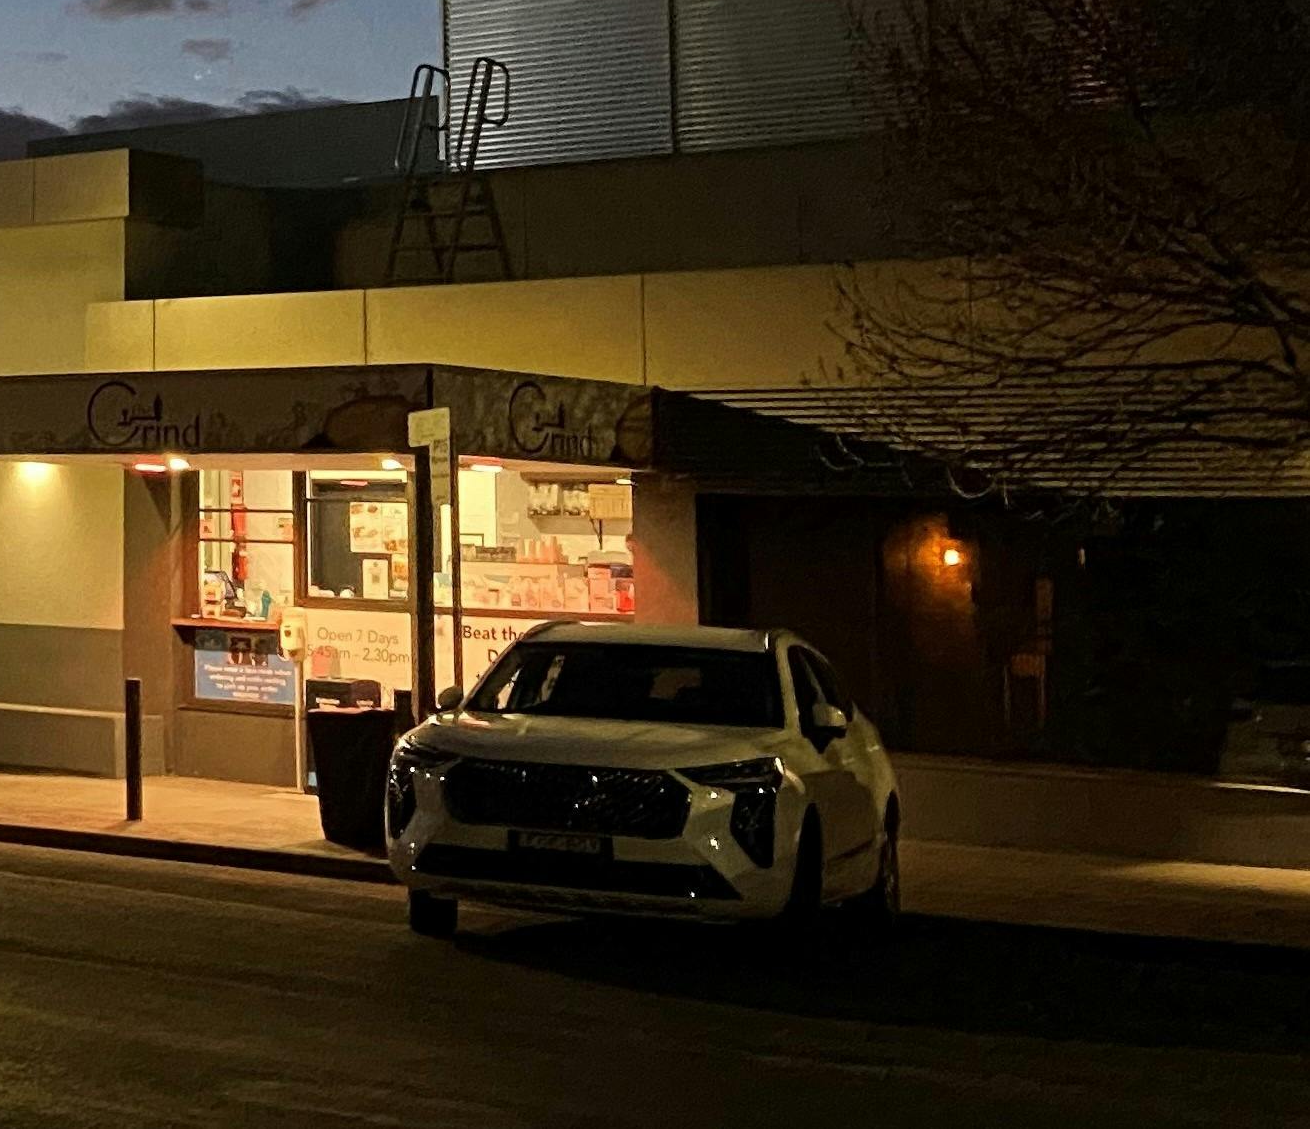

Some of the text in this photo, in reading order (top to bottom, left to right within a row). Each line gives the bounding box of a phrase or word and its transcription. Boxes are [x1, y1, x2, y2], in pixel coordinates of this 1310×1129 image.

[86, 381, 201, 448] Grind
[508, 380, 594, 455] Grind
[316, 627, 400, 649] Open 7 Days
[462, 625, 498, 641] Beat
[362, 647, 411, 666] 2.30pm
